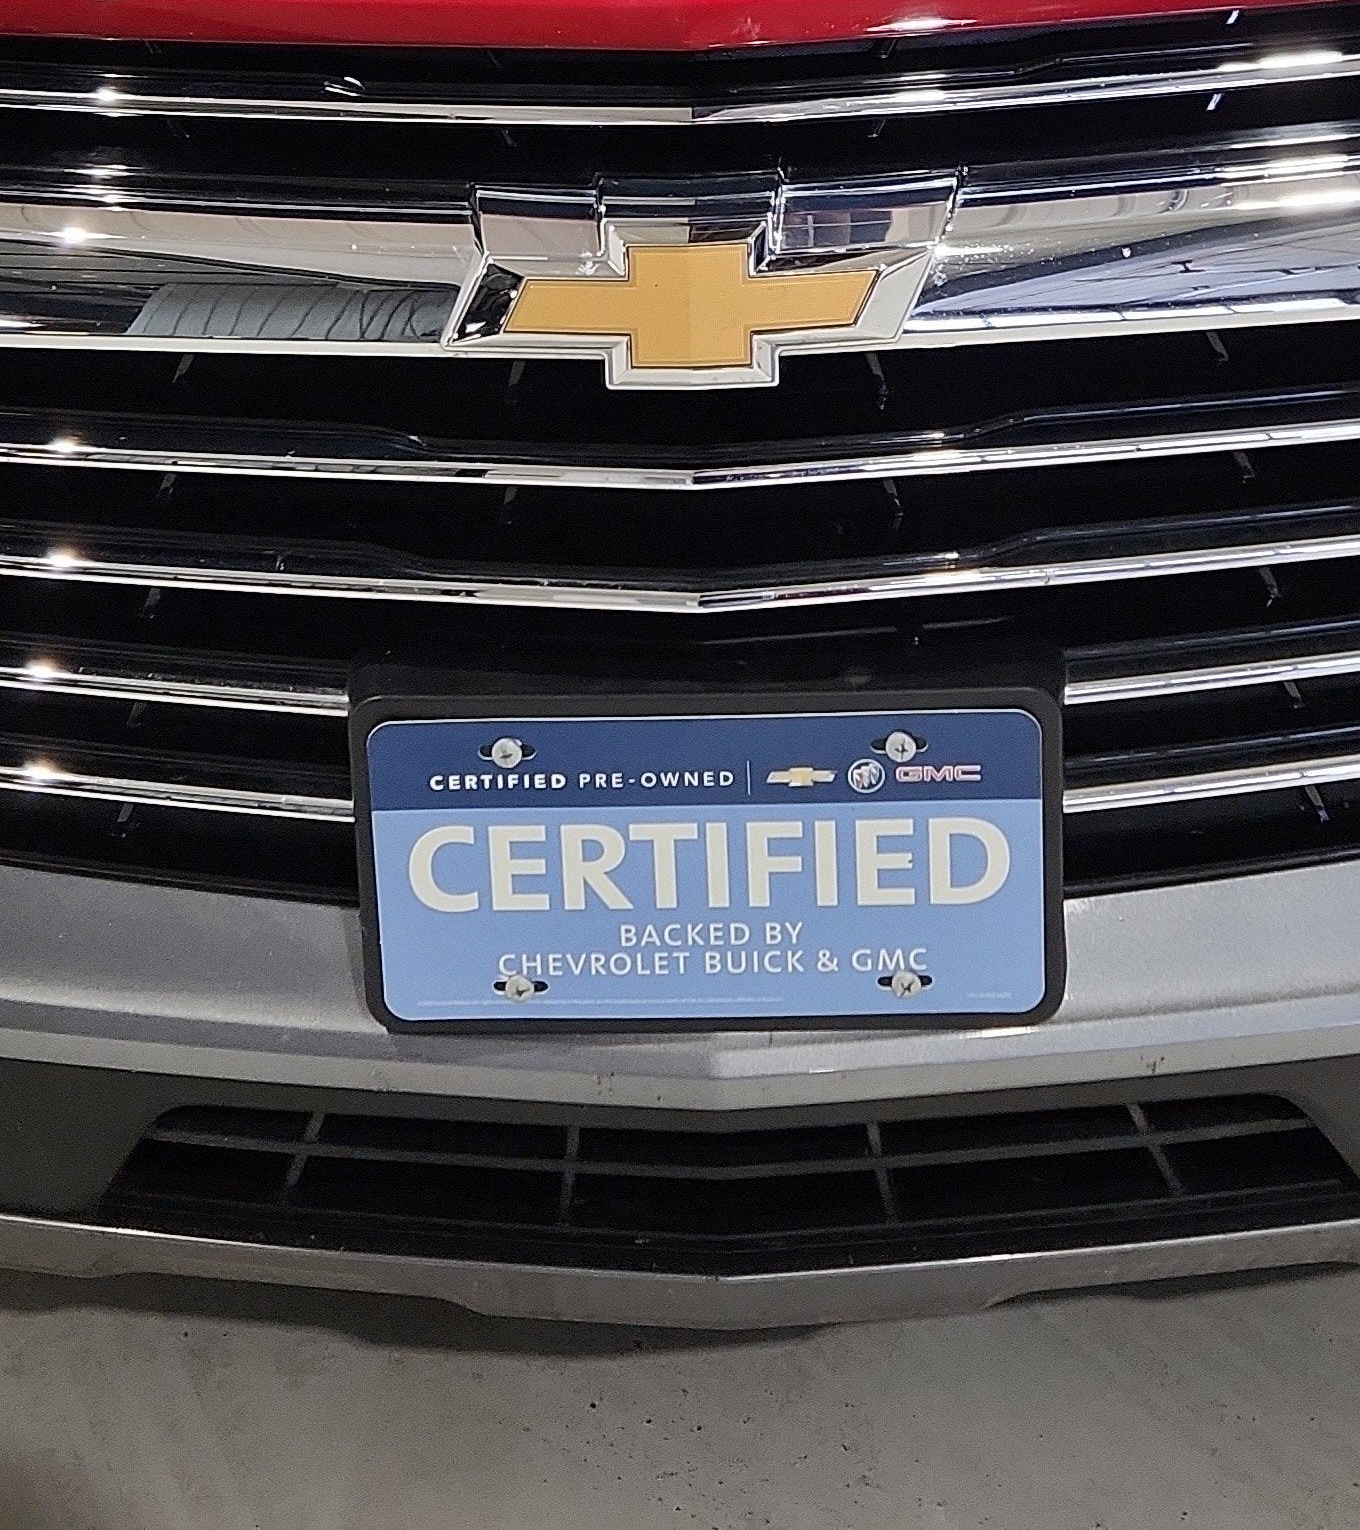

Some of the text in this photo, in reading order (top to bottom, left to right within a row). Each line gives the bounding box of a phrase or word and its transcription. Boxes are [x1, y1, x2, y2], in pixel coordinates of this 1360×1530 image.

[429, 765, 982, 791] CERTIFIED PRE-OWNED GMC
[408, 817, 1011, 913] CERTIFIED
[620, 922, 803, 947] BACKED BY
[498, 948, 928, 977] CHEVROLET BUICK & GMC
